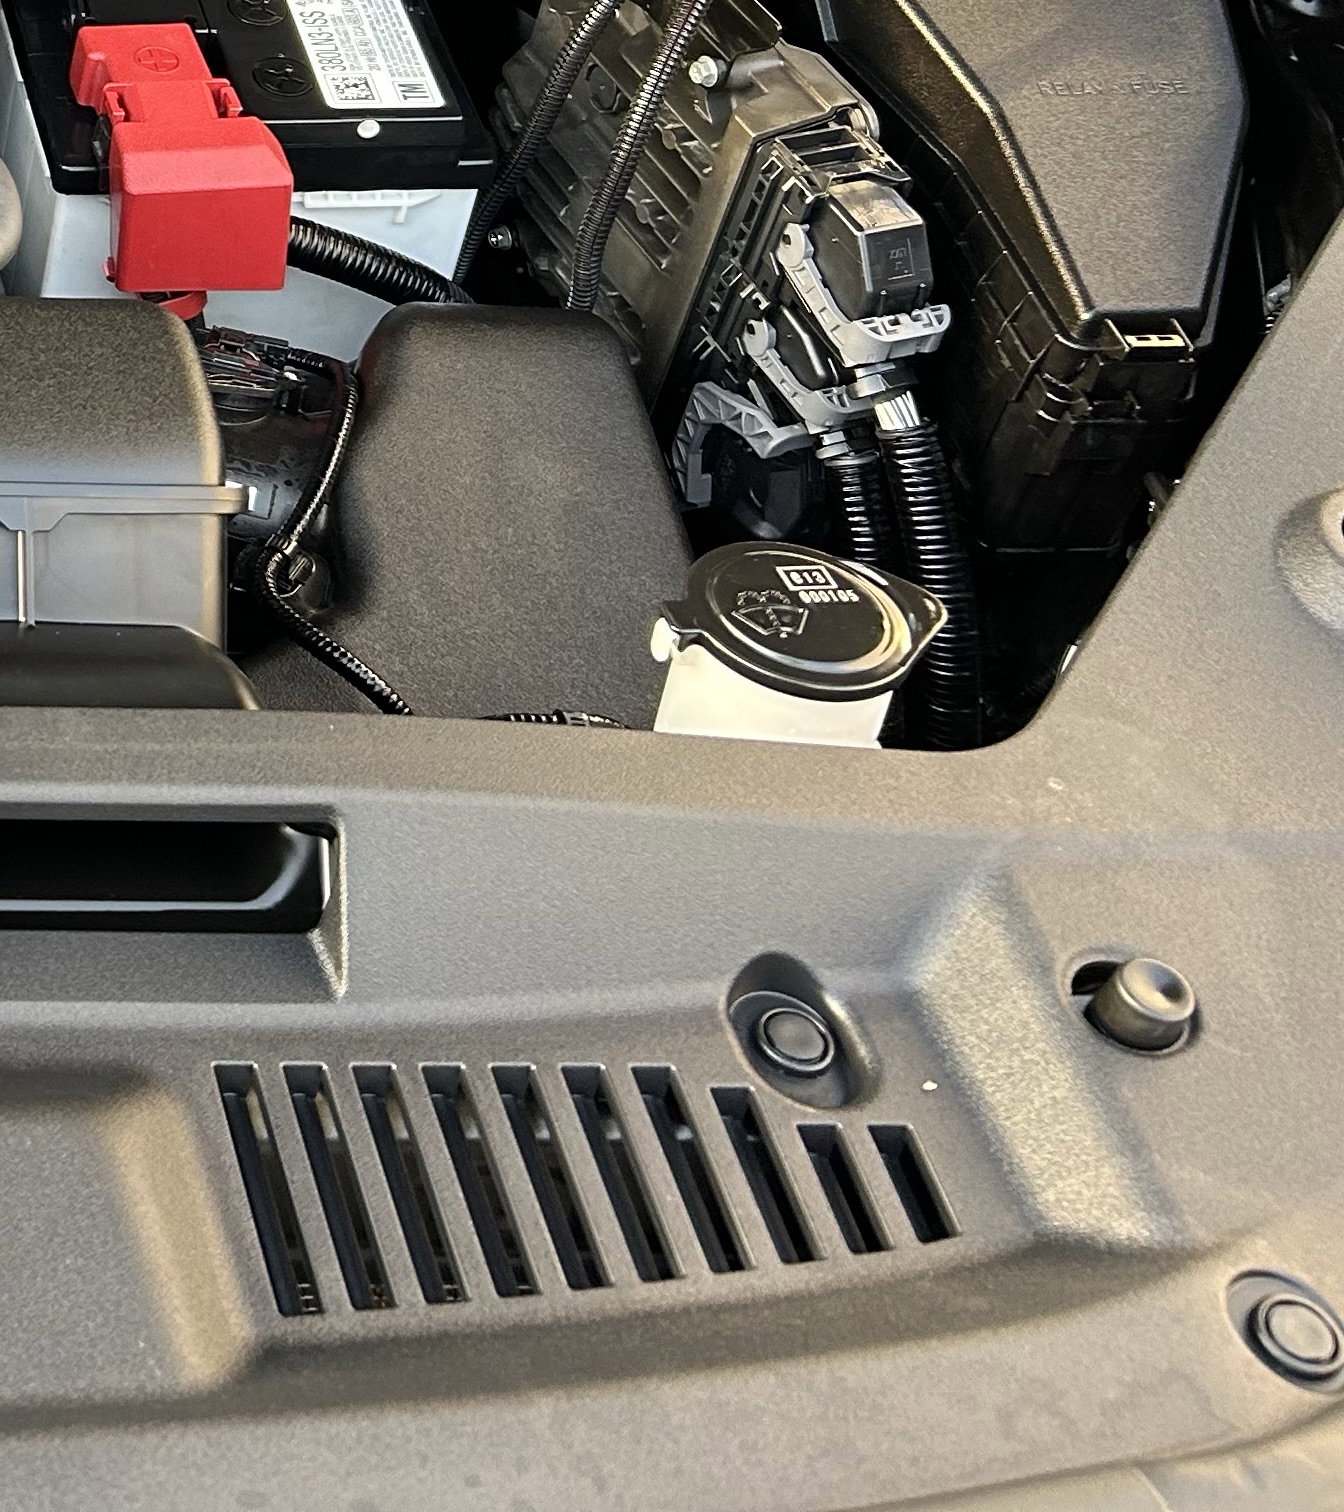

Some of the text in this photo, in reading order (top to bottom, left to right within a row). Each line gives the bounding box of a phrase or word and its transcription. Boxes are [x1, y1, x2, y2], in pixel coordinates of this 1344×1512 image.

[398, 83, 430, 101] TM
[1038, 80, 1103, 95] RELAY
[1130, 80, 1189, 95] FUSE
